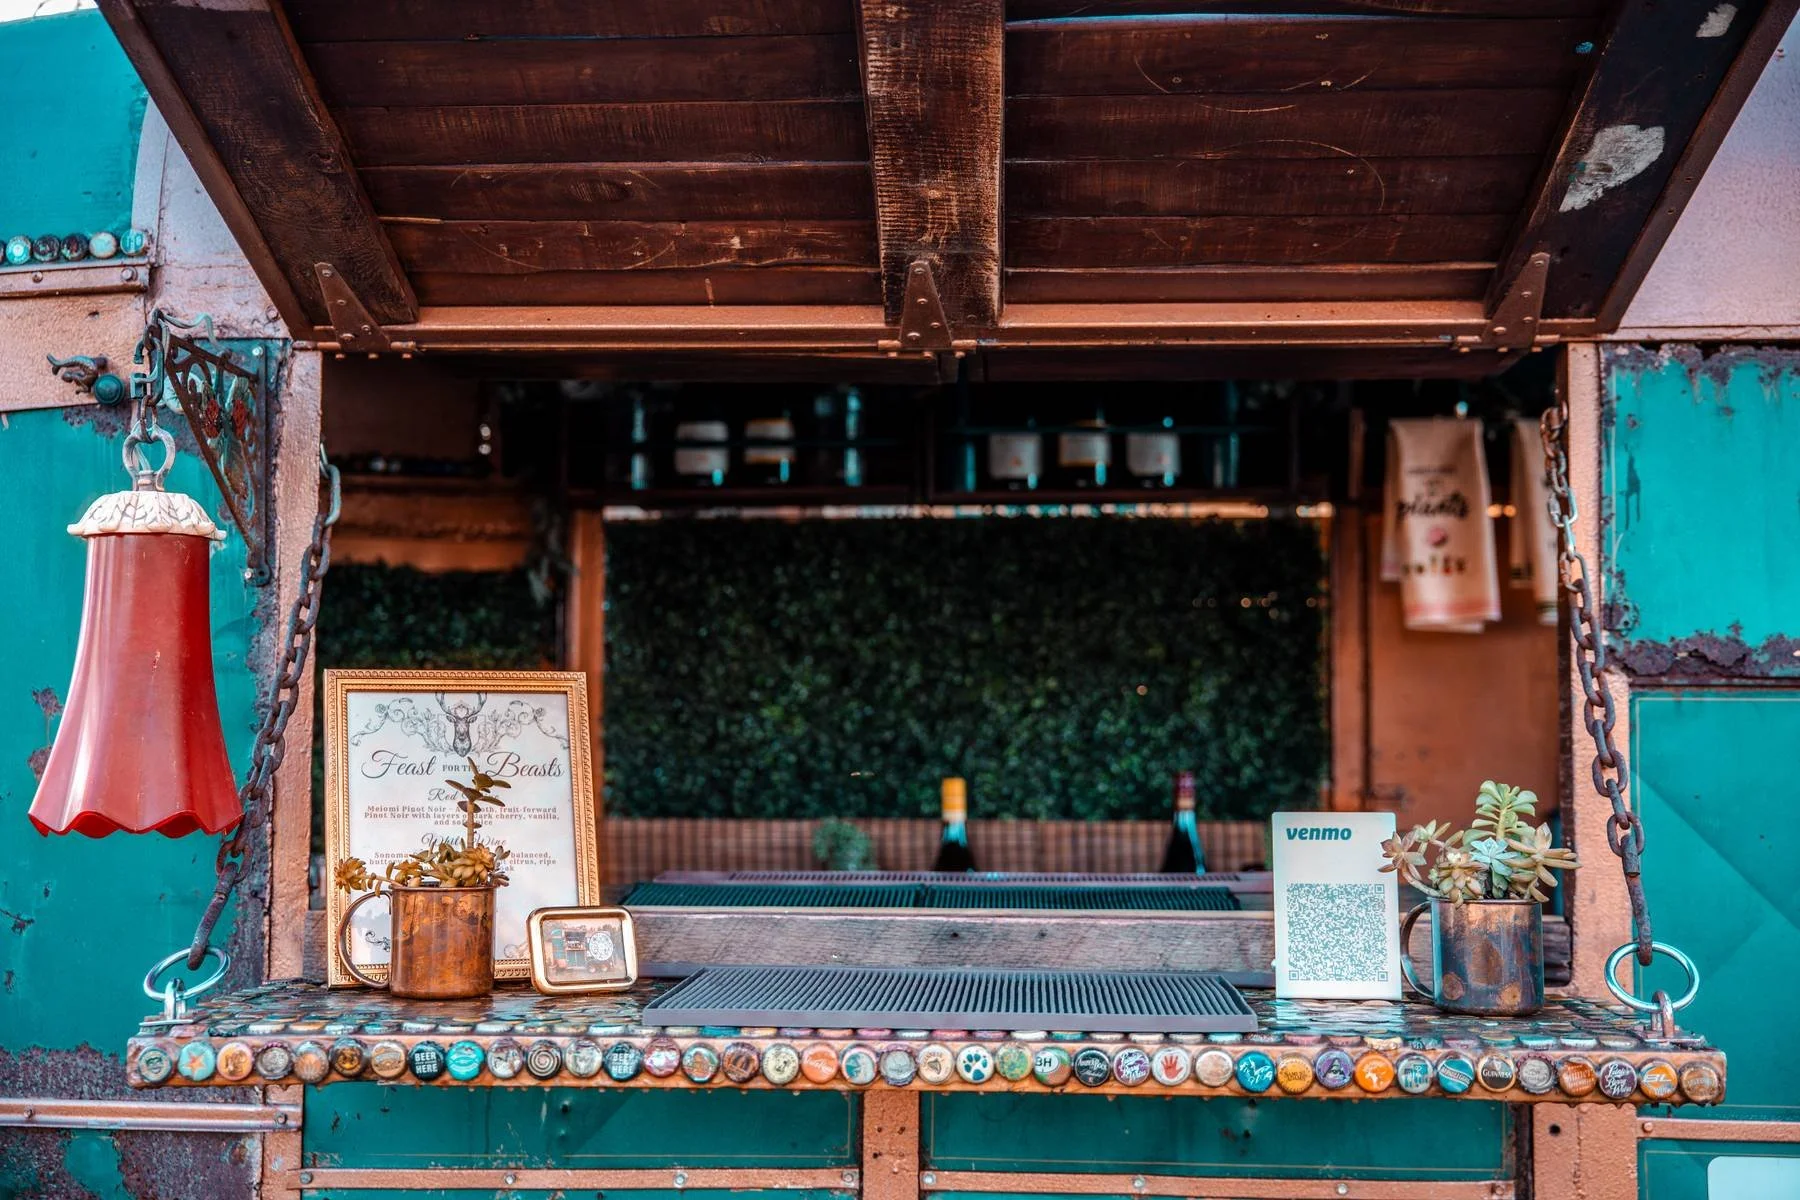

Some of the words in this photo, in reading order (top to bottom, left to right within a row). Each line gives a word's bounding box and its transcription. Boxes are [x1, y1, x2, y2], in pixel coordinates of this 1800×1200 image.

[361, 750, 436, 778] Feast
[485, 751, 563, 777] Beasts
[428, 788, 457, 800] Red
[433, 812, 460, 820] layers
[495, 812, 526, 820] cherry,
[528, 813, 560, 821] vanilla,
[421, 832, 464, 847] Whit
[1286, 827, 1352, 841] venmo
[414, 1051, 437, 1062] BEER
[612, 1052, 635, 1063] BEER
[415, 1063, 438, 1074] HERE
[612, 1064, 634, 1075] HERE
